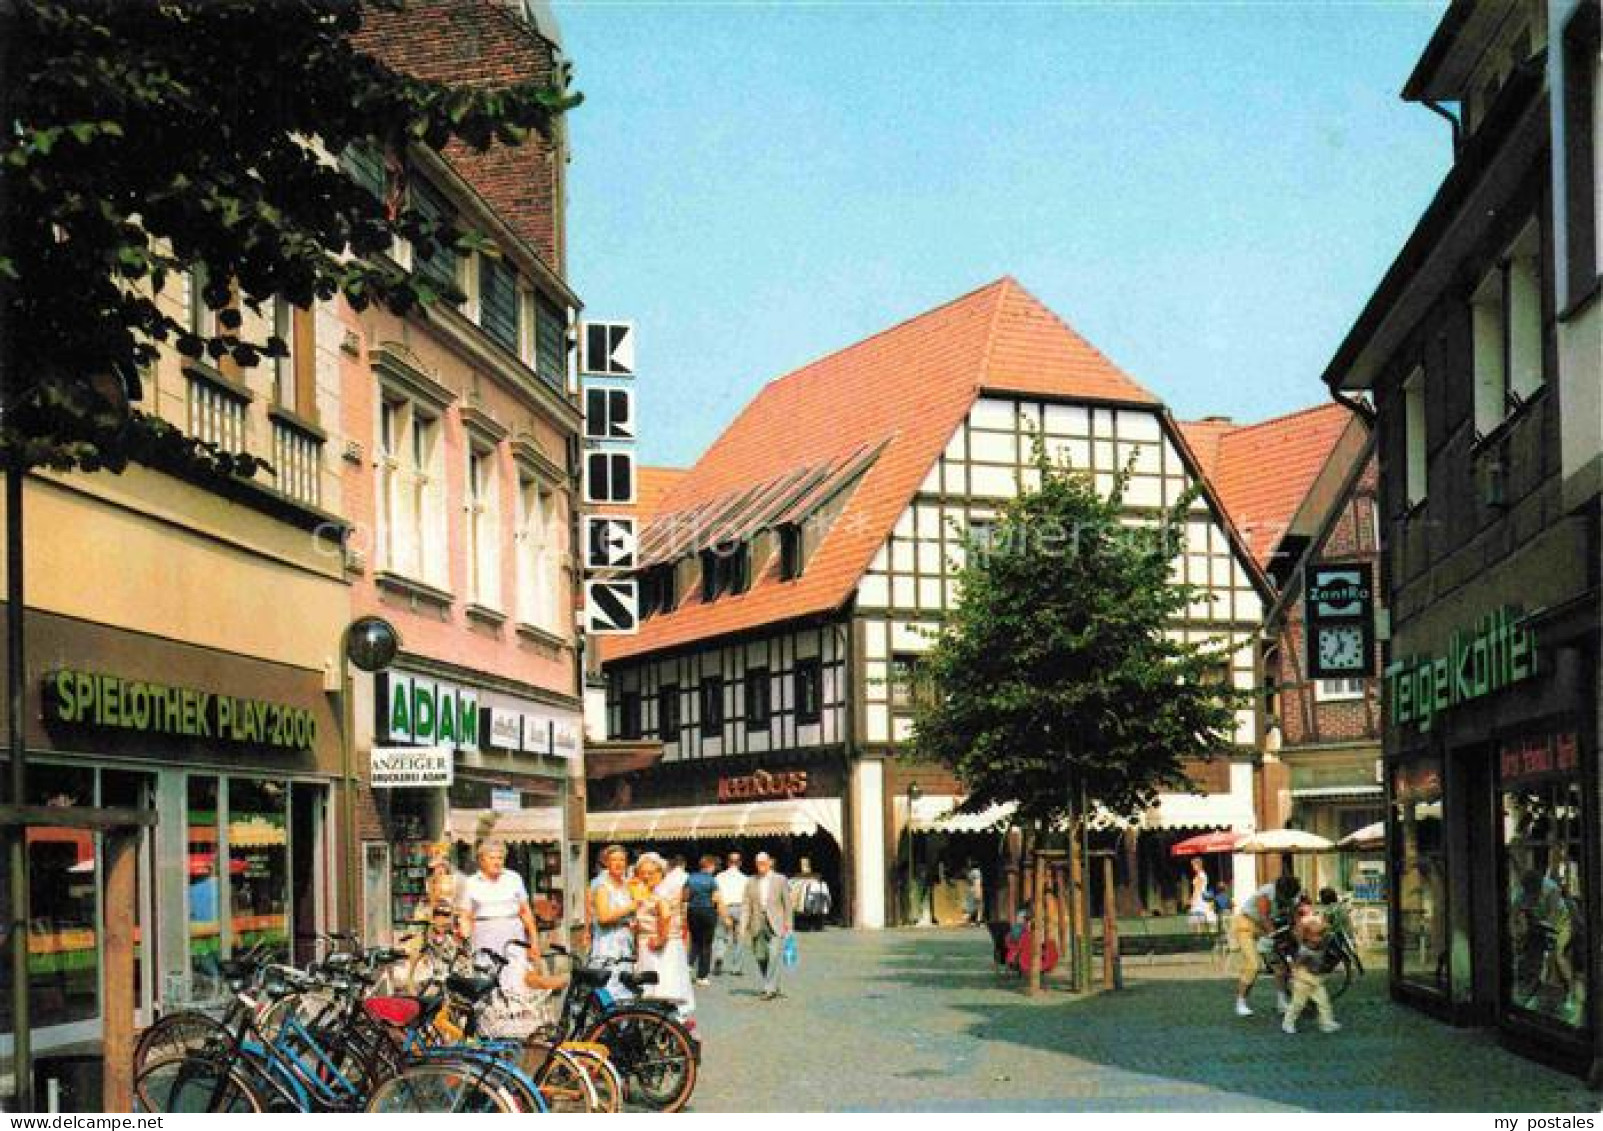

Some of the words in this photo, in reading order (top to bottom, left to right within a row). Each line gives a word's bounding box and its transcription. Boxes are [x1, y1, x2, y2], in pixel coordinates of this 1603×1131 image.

[587, 323, 634, 632] KRIES
[56, 669, 211, 737] SPIELOTHEK
[391, 682, 477, 745] ADAM
[371, 757, 447, 770] ANZEIGER
